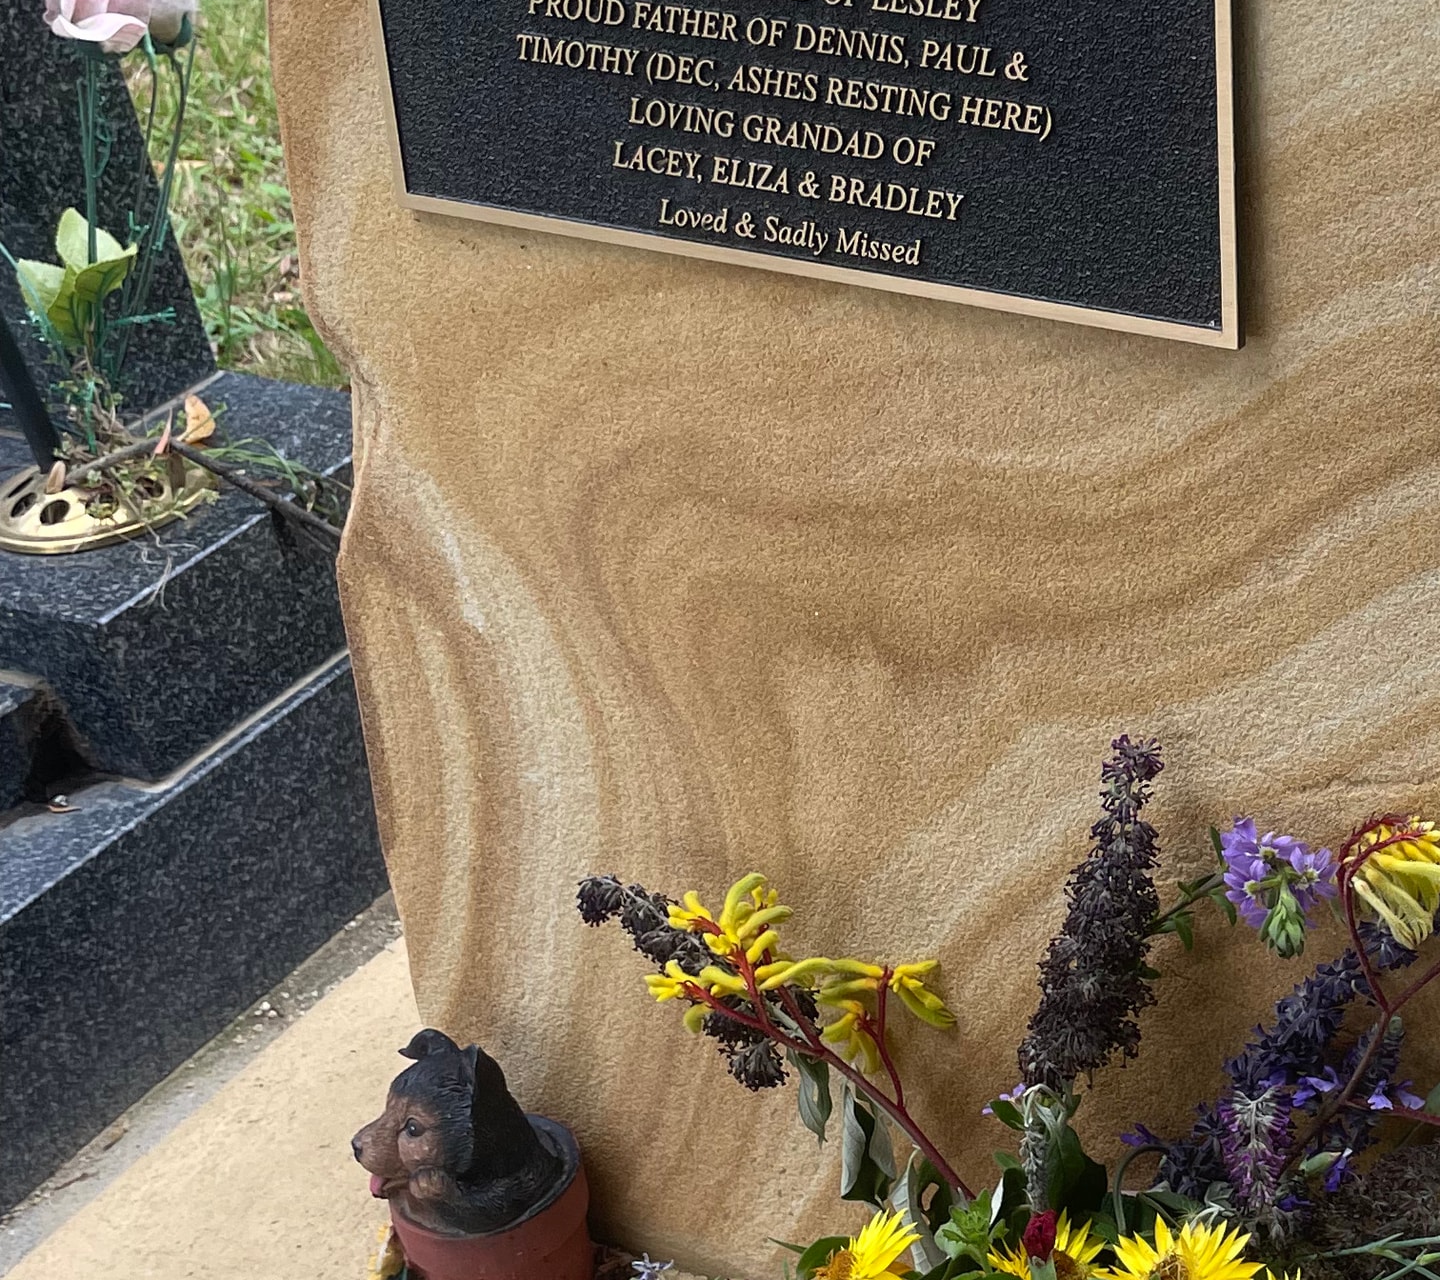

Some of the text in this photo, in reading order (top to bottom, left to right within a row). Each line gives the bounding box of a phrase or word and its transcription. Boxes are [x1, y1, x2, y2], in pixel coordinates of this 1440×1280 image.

[631, 0, 739, 43] FATHER
[745, 16, 788, 48] OF
[792, 22, 910, 67] DENNIS,
[918, 38, 997, 78] PAUL
[1003, 50, 1030, 83] &
[515, 32, 1053, 142] TIMOTHY (DEC, ASHES RESTING HERE)
[627, 96, 937, 168] LOVING GRANDAD OF
[611, 140, 962, 222] LACEY, ELIZA & BRADLEY
[657, 197, 922, 267] Loved & Sadly Missed
